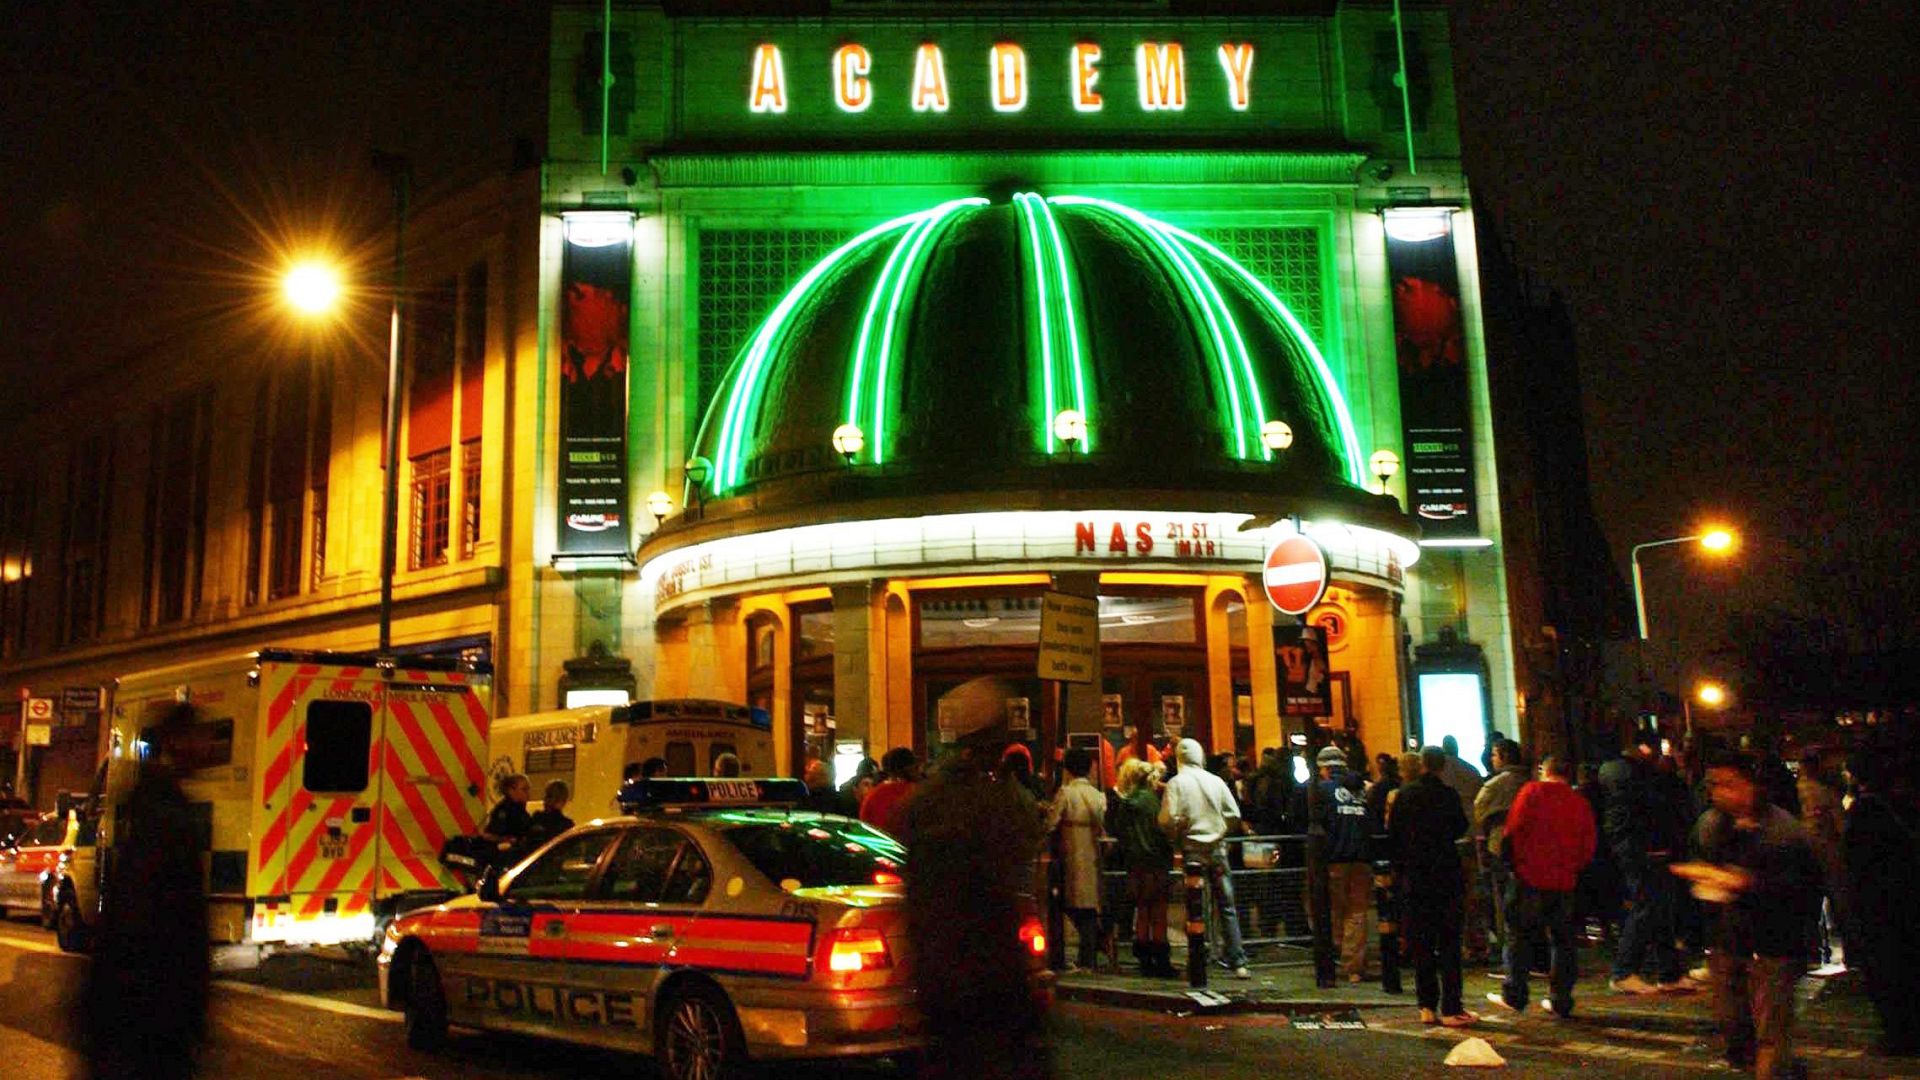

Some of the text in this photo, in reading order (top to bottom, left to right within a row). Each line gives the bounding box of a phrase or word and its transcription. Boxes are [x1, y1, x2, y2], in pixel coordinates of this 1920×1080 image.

[749, 42, 1254, 113] ACADEMY
[1075, 522, 1154, 553] NAS
[1178, 540, 1215, 556] MAR
[323, 688, 371, 700] LONDON
[524, 726, 578, 745] AMBULANCE
[708, 782, 757, 799] POLICE
[466, 980, 632, 1025] POLICE
